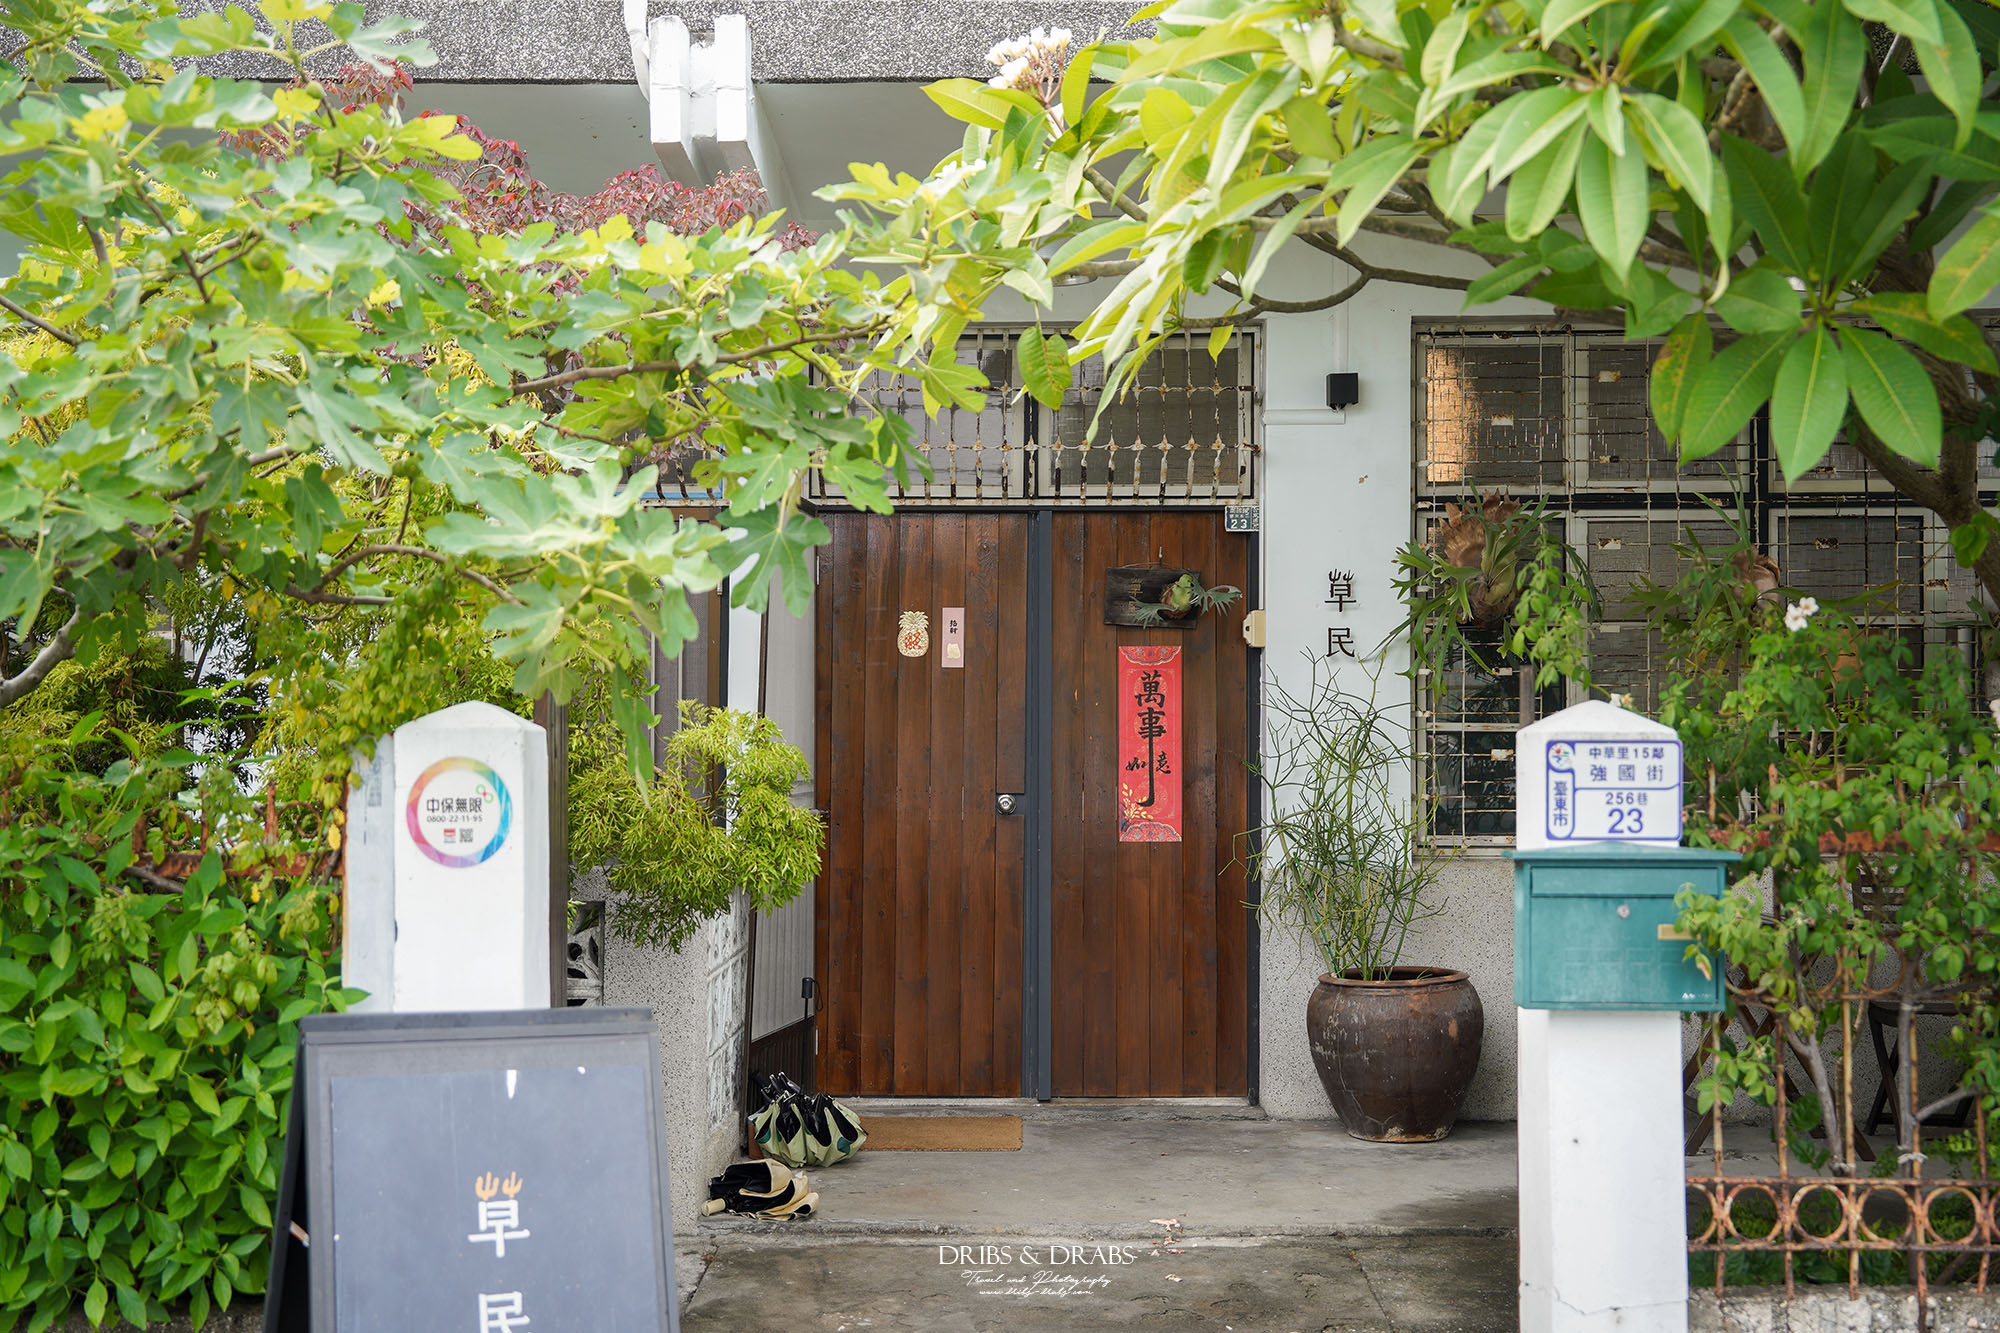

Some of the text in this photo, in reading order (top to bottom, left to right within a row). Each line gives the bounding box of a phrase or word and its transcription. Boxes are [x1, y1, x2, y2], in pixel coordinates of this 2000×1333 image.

[1230, 518, 1248, 529] 23
[1324, 568, 1356, 658] 草民
[426, 797, 482, 813] 中保無限
[1552, 780, 1569, 827] 臺東市
[1604, 792, 1648, 806] 256巷
[1607, 807, 1644, 834] 23
